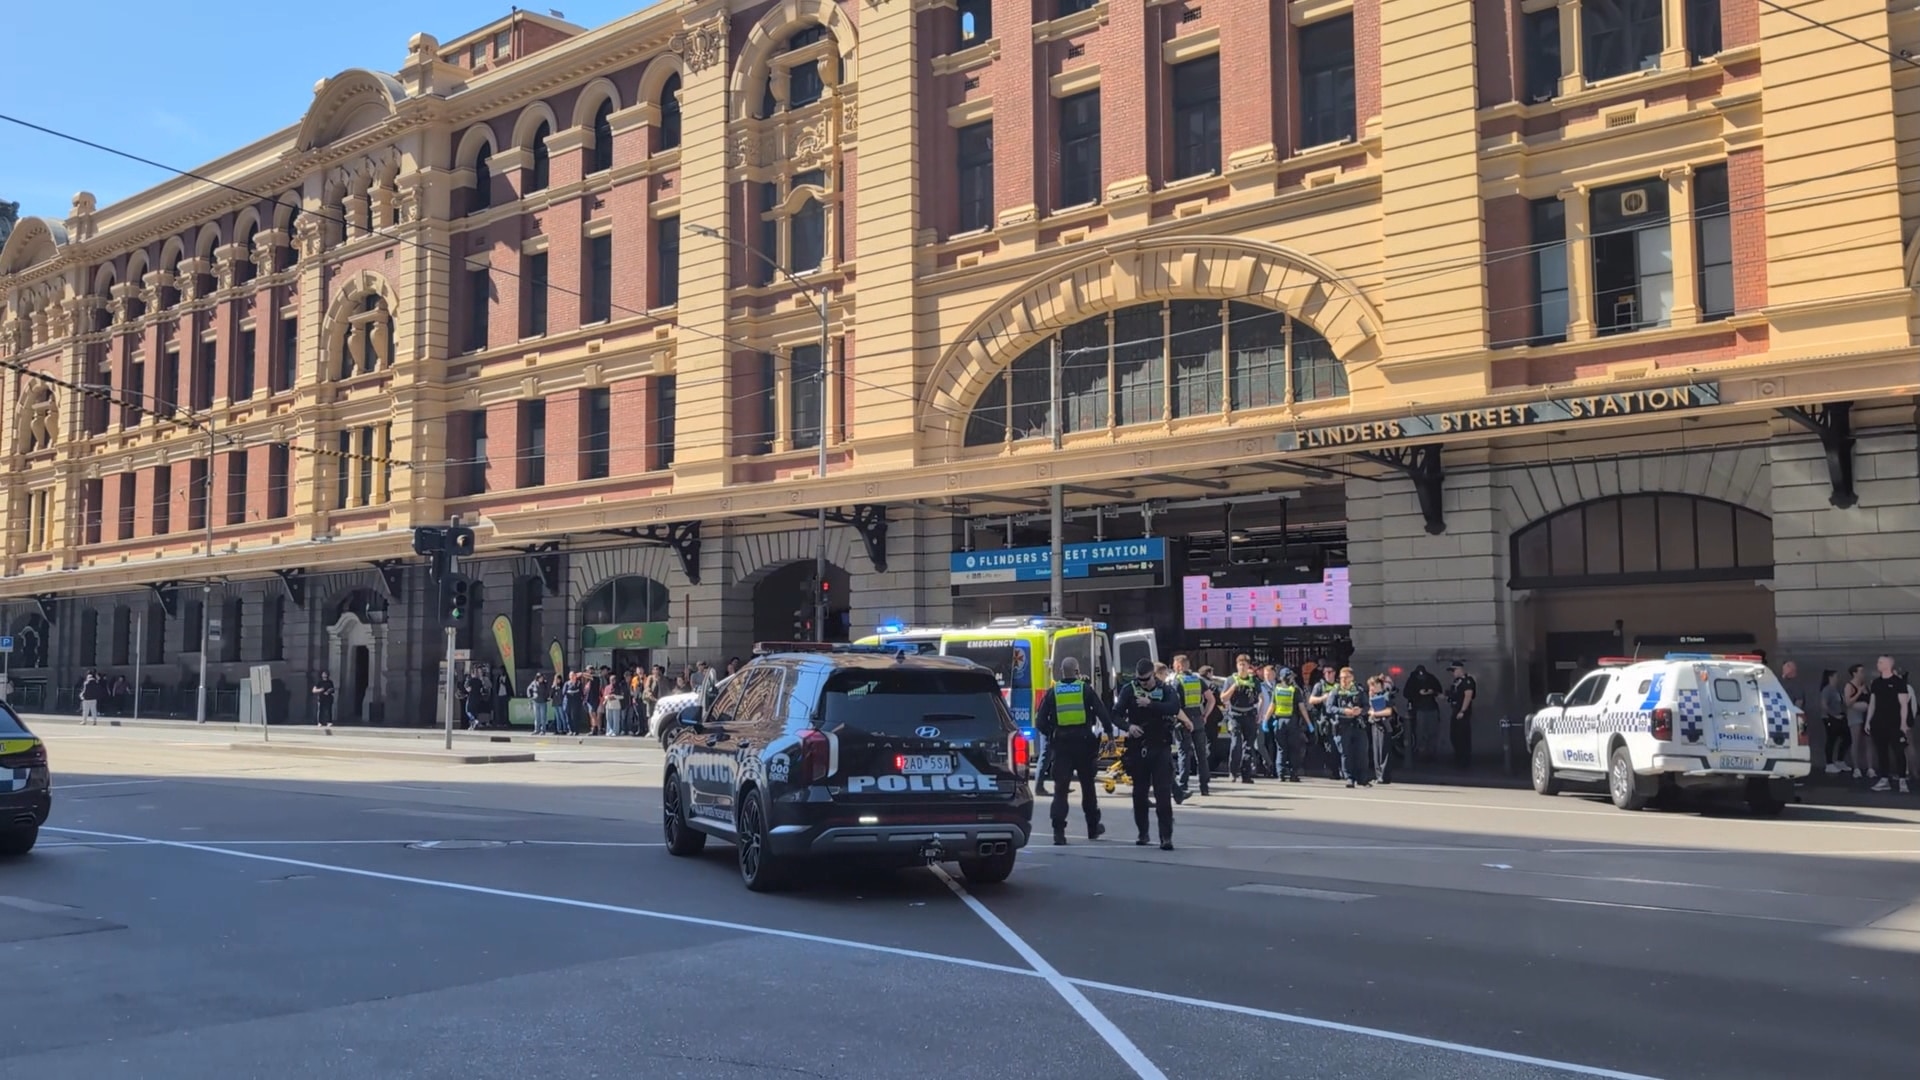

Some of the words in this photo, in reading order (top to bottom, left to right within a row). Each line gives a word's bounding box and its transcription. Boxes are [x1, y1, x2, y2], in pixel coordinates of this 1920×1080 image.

[1296, 420, 1400, 450] FLINDERS
[1440, 404, 1529, 432] STREET
[1571, 387, 1690, 418] STATION
[979, 552, 1037, 566] FLINDERS
[1041, 548, 1087, 562] SEET
[1091, 544, 1148, 559] STATION
[967, 639, 1014, 649] EMERGENCY
[1056, 684, 1080, 693] Police
[1566, 749, 1595, 762] Police
[770, 763, 790, 774] 000
[848, 774, 999, 793] POLICE
